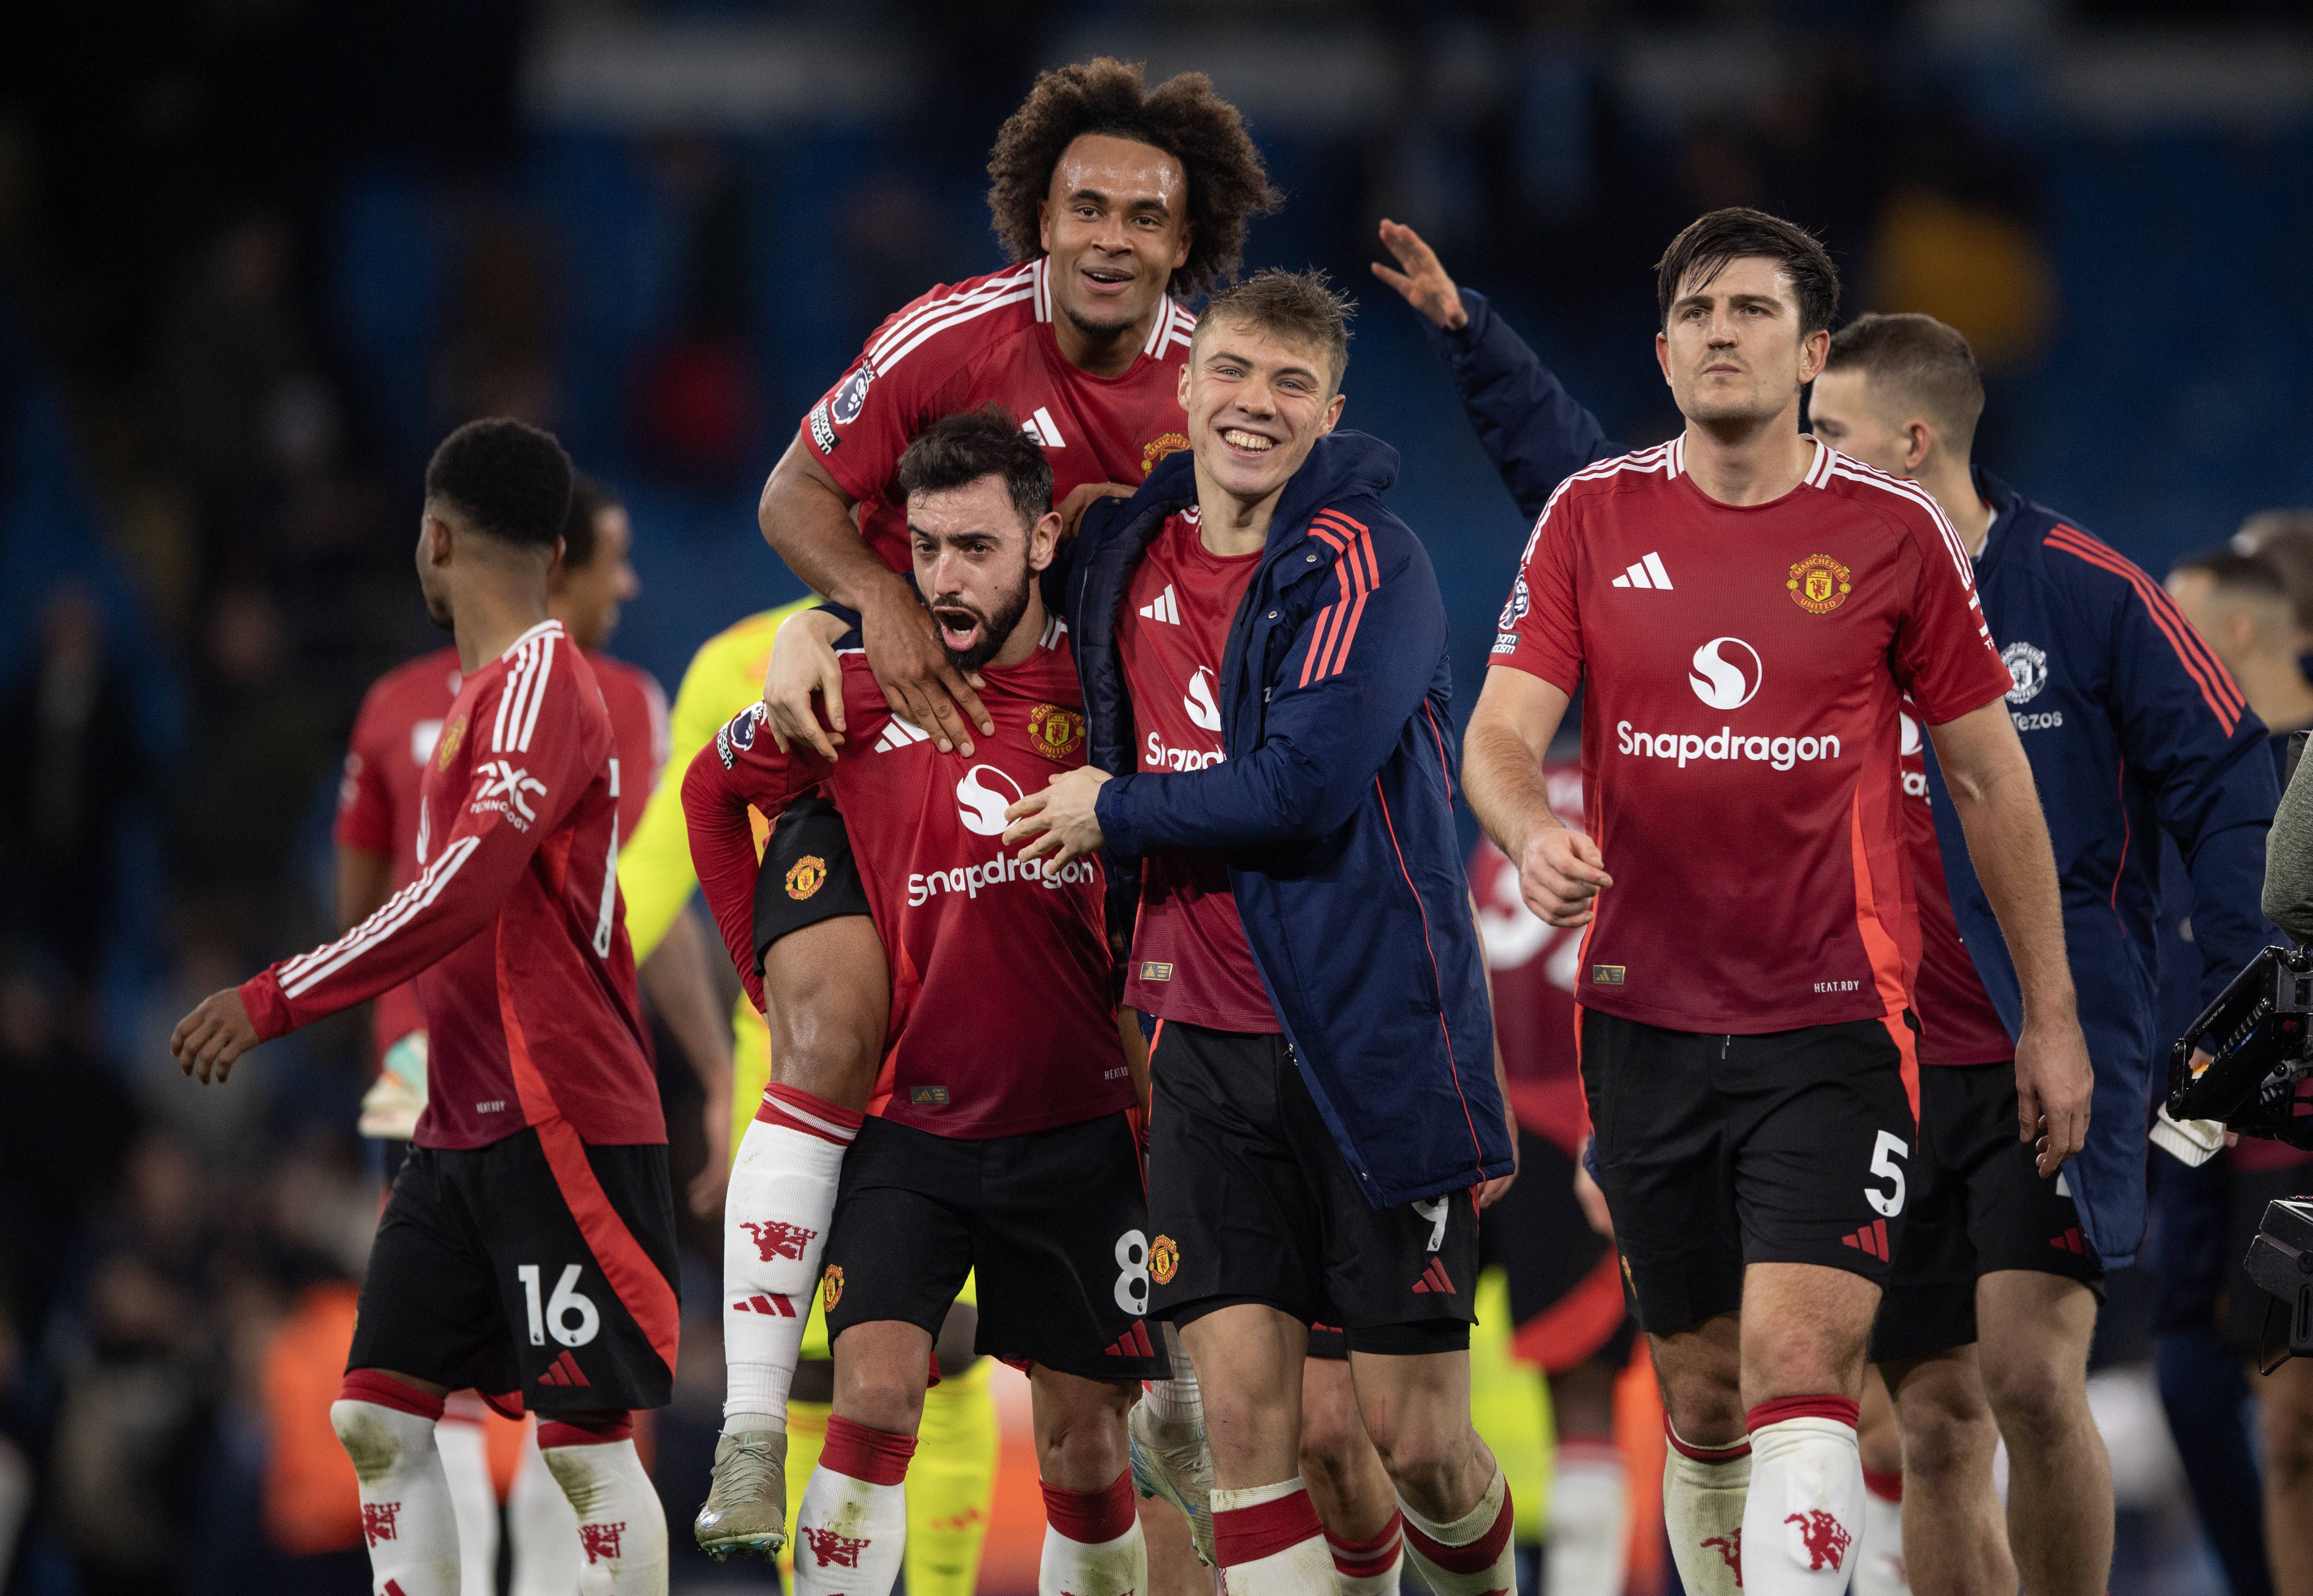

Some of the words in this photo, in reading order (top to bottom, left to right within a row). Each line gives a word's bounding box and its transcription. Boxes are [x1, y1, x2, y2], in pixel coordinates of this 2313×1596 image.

[811, 419, 832, 455] racism
[820, 413, 834, 444] room
[1794, 558, 1845, 579] MANCHESTER
[1800, 598, 1836, 610] UNITED
[1495, 634, 1517, 644] oom
[2010, 711, 2063, 731] Tezos
[1040, 742, 1071, 754] UNITED
[1616, 720, 1841, 771] Snapdragon
[470, 800, 530, 834] TECHNOOGY
[789, 859, 822, 879] MANCHESTER
[908, 851, 1093, 907] Snapdragon
[795, 884, 818, 897] UNITED
[1814, 980, 1859, 993] HEAT.RDY
[1864, 1130, 1908, 1217] 5
[1411, 1195, 1448, 1251] 9
[1150, 1238, 1174, 1258] MANCHESTER
[1114, 1229, 1149, 1315] 8
[1156, 1270, 1174, 1281] UNITED
[518, 1264, 600, 1347] 16
